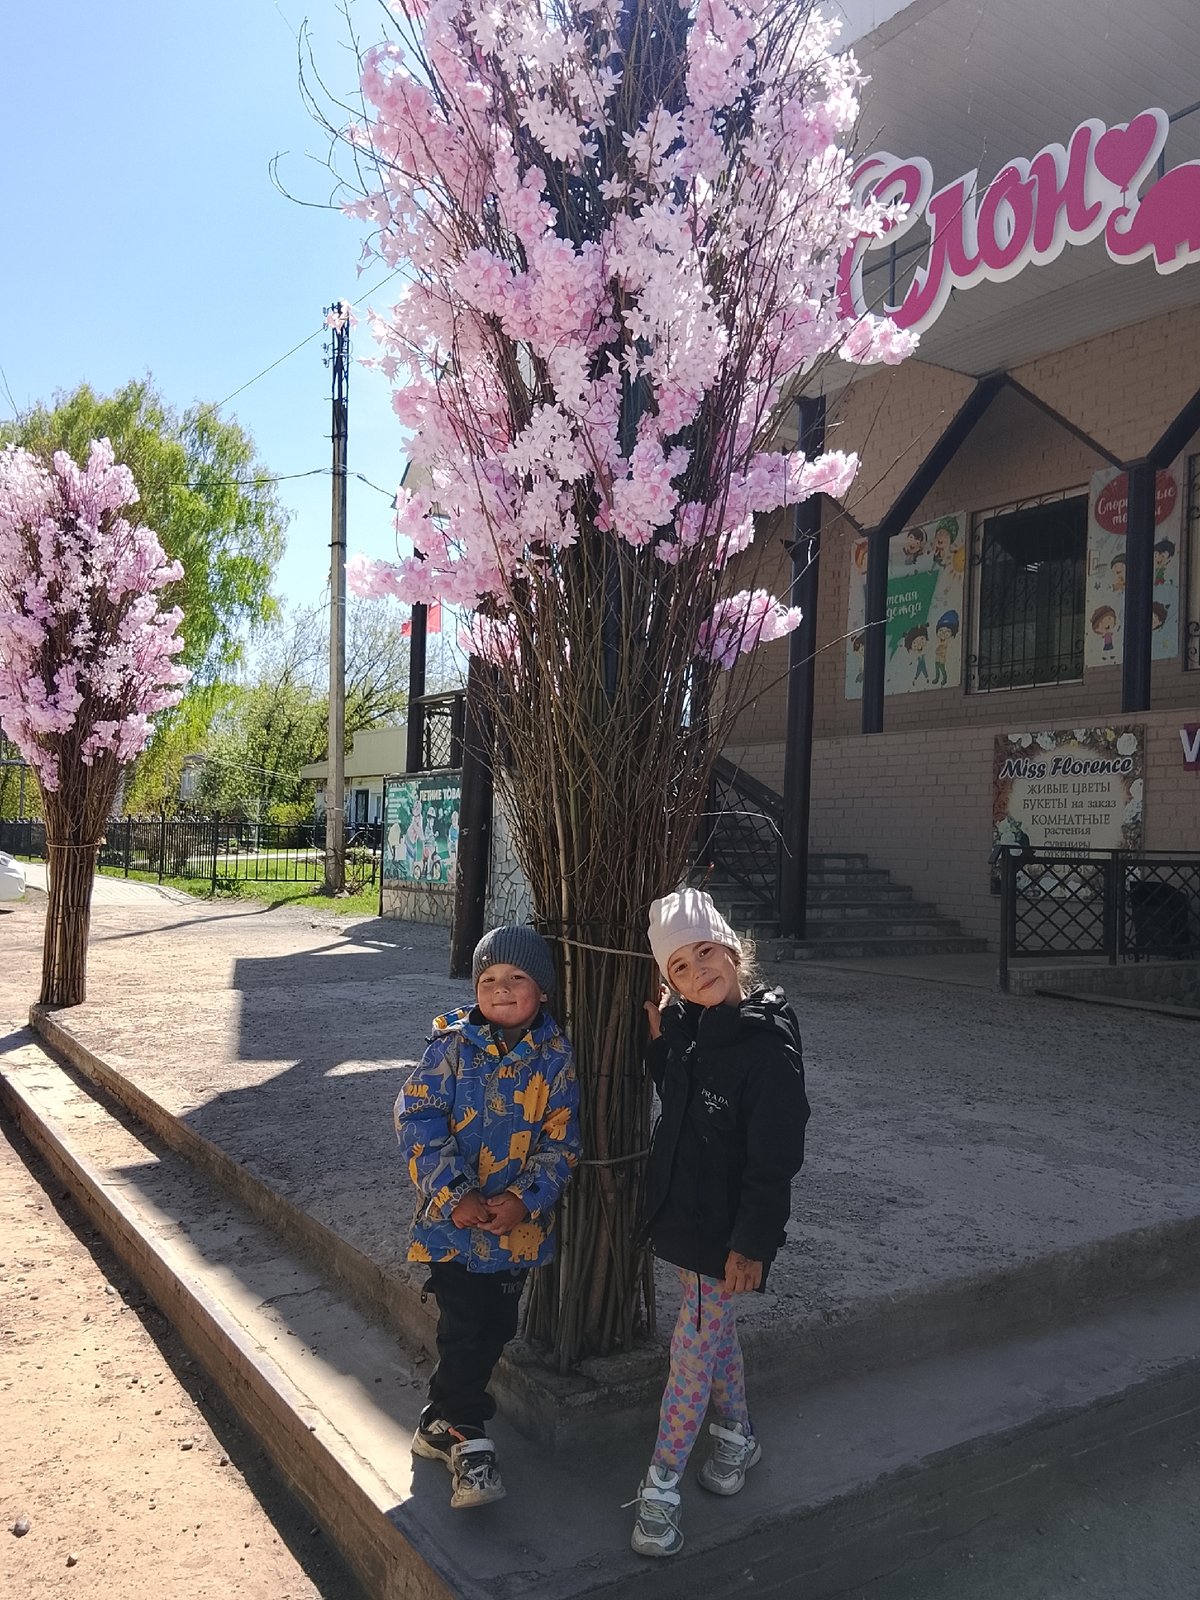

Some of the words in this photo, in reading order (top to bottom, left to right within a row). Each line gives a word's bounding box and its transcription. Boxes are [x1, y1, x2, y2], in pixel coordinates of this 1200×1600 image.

[836, 124, 1102, 330] Слон
[886, 591, 918, 607] тская
[886, 602, 922, 623] дежда
[1001, 759, 1046, 779] Miss
[1051, 757, 1132, 776] Florence
[420, 789, 442, 802] ЛЕТНИЕ
[443, 787, 462, 801] ТОВА
[1027, 783, 1068, 794] ЖИВЫЕ
[1072, 782, 1110, 795] ЦВЕТЫ
[1023, 798, 1067, 810] БУКЕТЫ
[1071, 801, 1084, 809] на
[1088, 800, 1116, 808] заказ
[1031, 814, 1110, 825] КОМНАТНЫЕ
[1044, 828, 1091, 838] растения
[701, 1088, 729, 1107] PRADA
